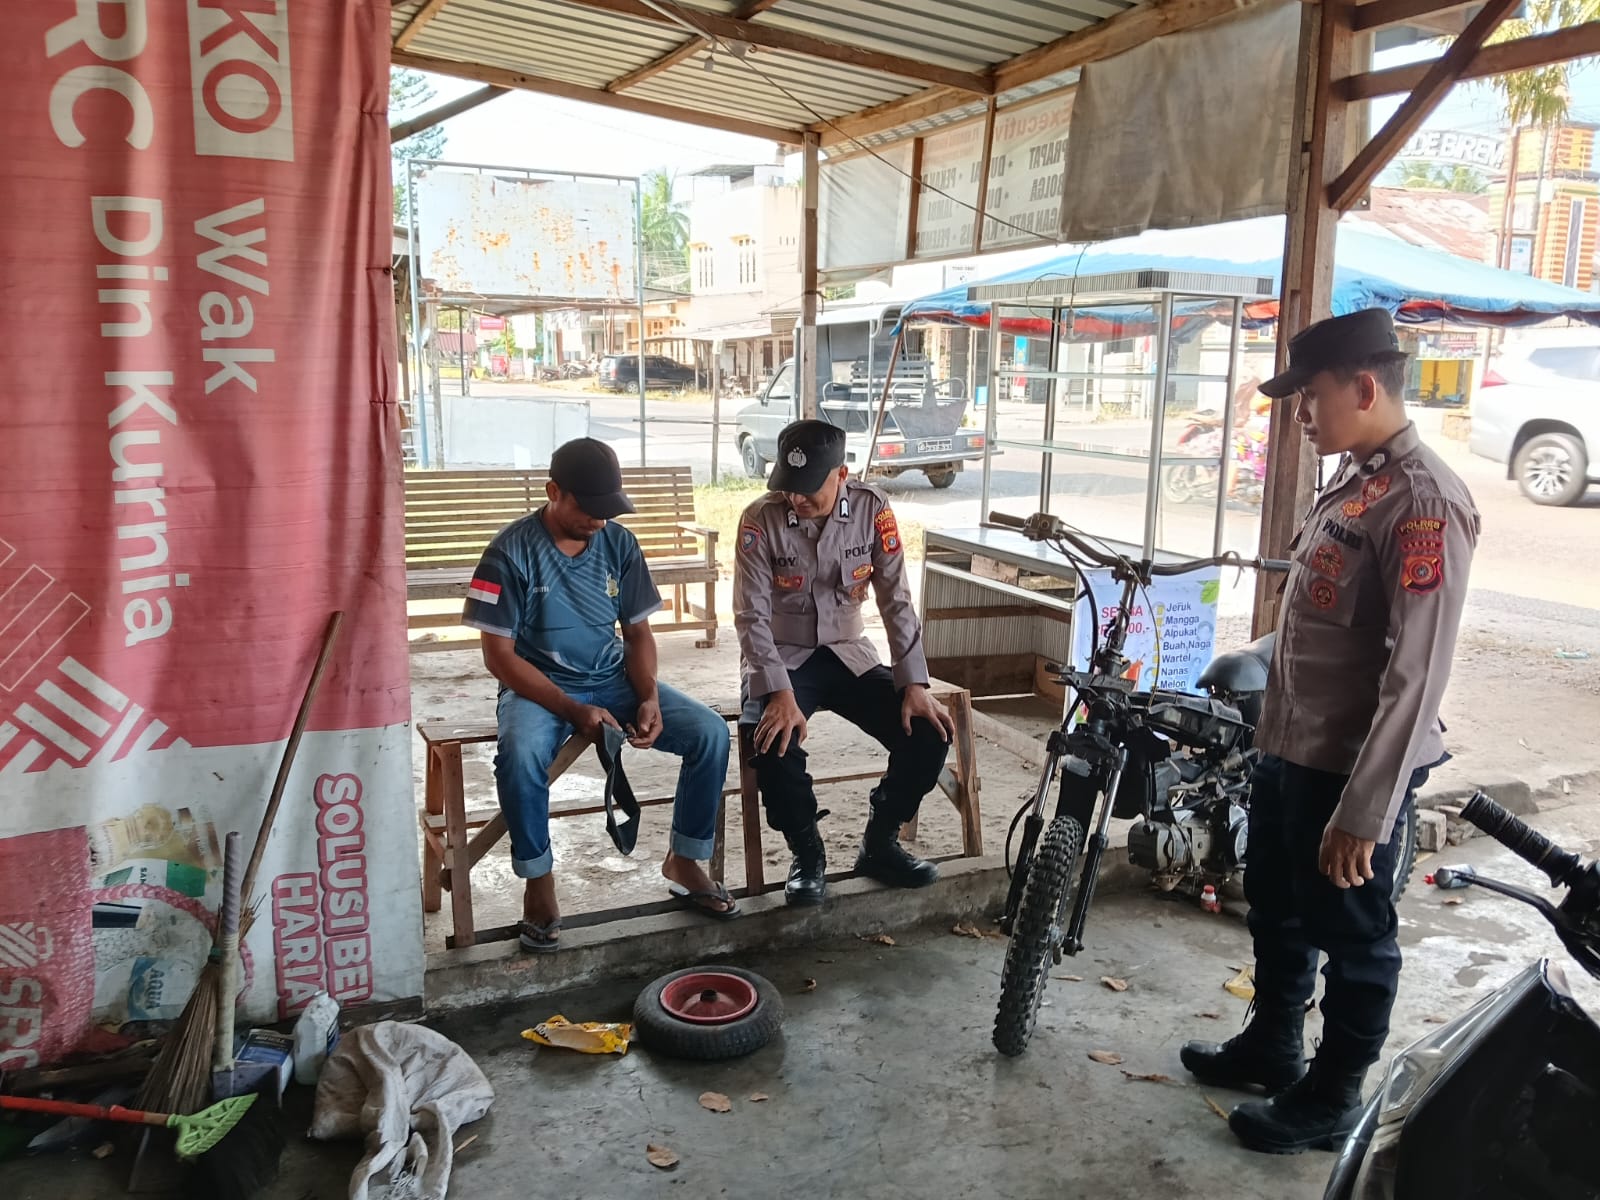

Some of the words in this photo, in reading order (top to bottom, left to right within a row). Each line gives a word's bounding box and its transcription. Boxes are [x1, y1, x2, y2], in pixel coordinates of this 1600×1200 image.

[200, 0, 282, 134] KO
[91, 196, 168, 337] Din
[194, 198, 275, 394] Wak
[104, 371, 190, 647] Kurnia
[1165, 615, 1200, 626] Mangga
[1166, 603, 1191, 612] Jeruk
[1163, 641, 1186, 651] Buah
[1188, 640, 1211, 651] Naga
[1164, 628, 1197, 639] Alpukat
[1161, 667, 1188, 676] Nanas
[1161, 680, 1186, 689] Melon
[317, 775, 368, 933] SOLUSI
[275, 874, 324, 1017] HARIA
[149, 967, 164, 1010] AQUA
